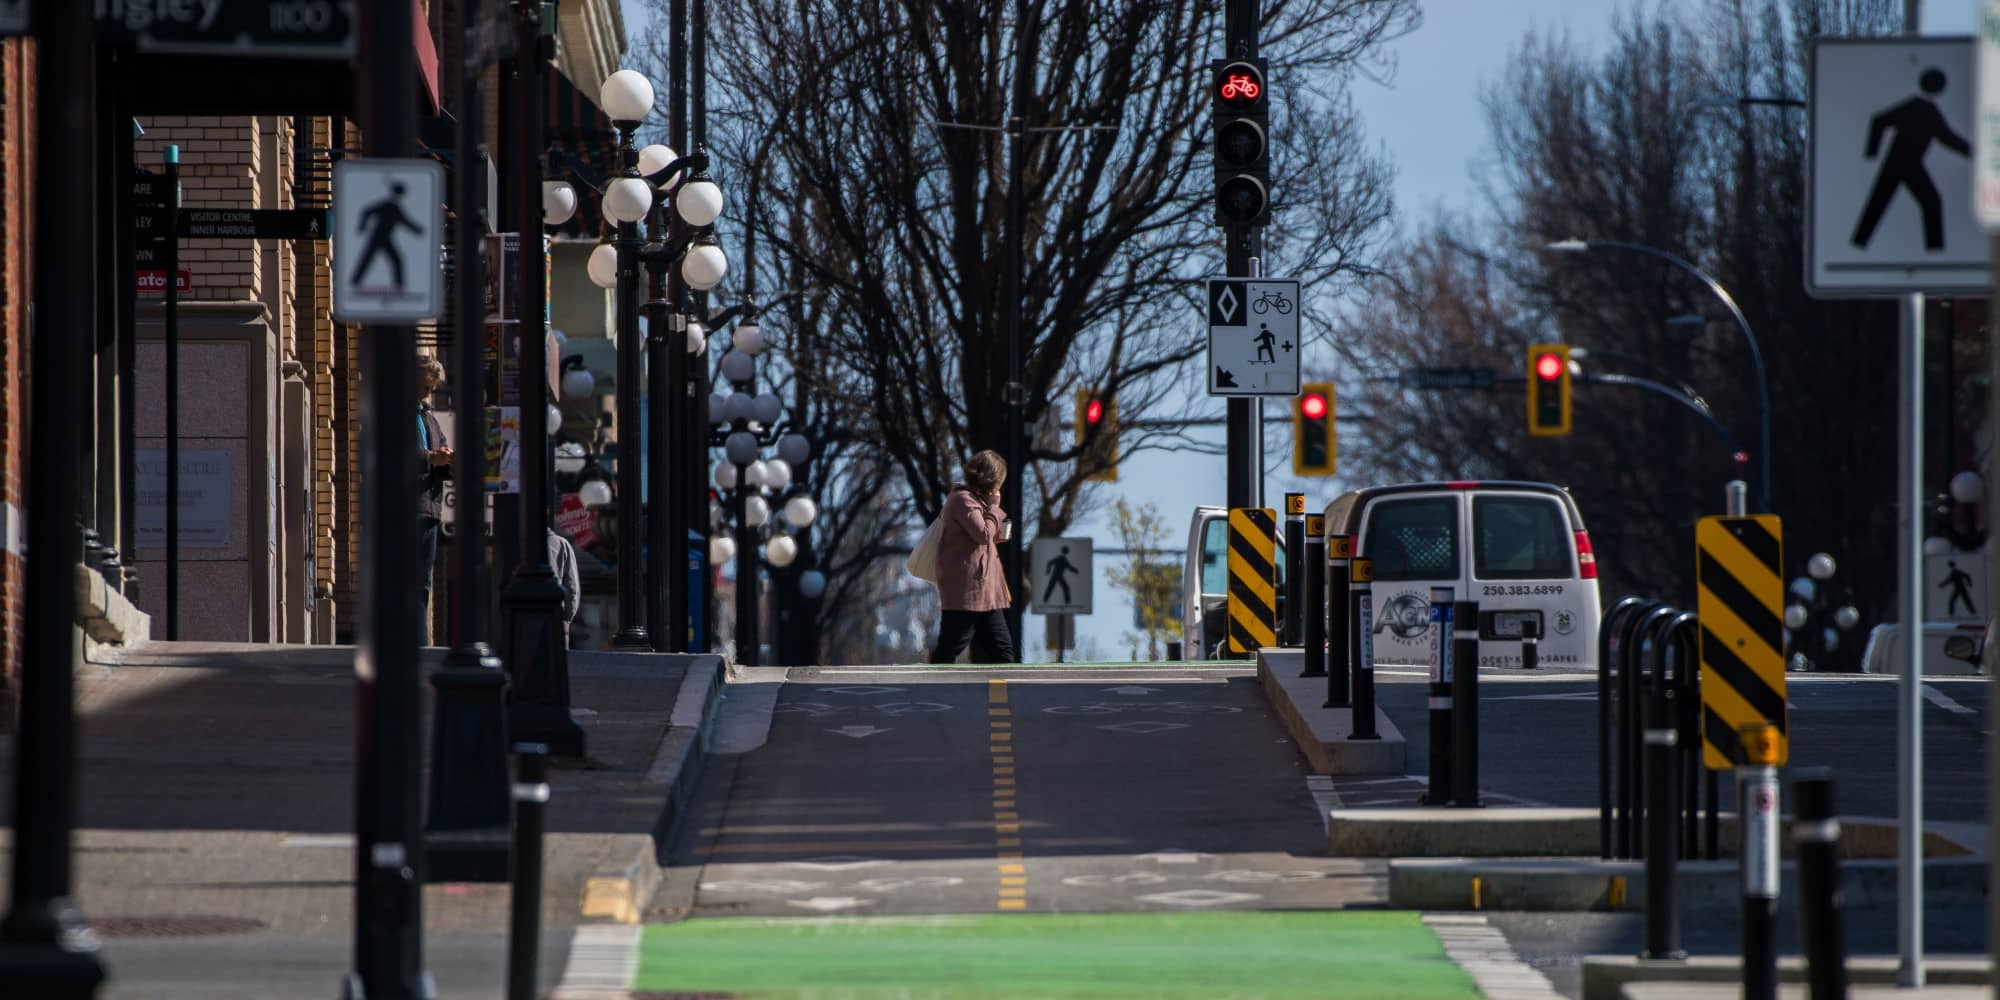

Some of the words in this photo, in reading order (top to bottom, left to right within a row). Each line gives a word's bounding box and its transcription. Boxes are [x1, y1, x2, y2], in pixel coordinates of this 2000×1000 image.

[190, 211, 221, 222] VISITOR
[190, 225, 215, 236] INNER
[217, 225, 256, 236] HARBOUR
[1483, 585, 1563, 596] 250.383.6899
